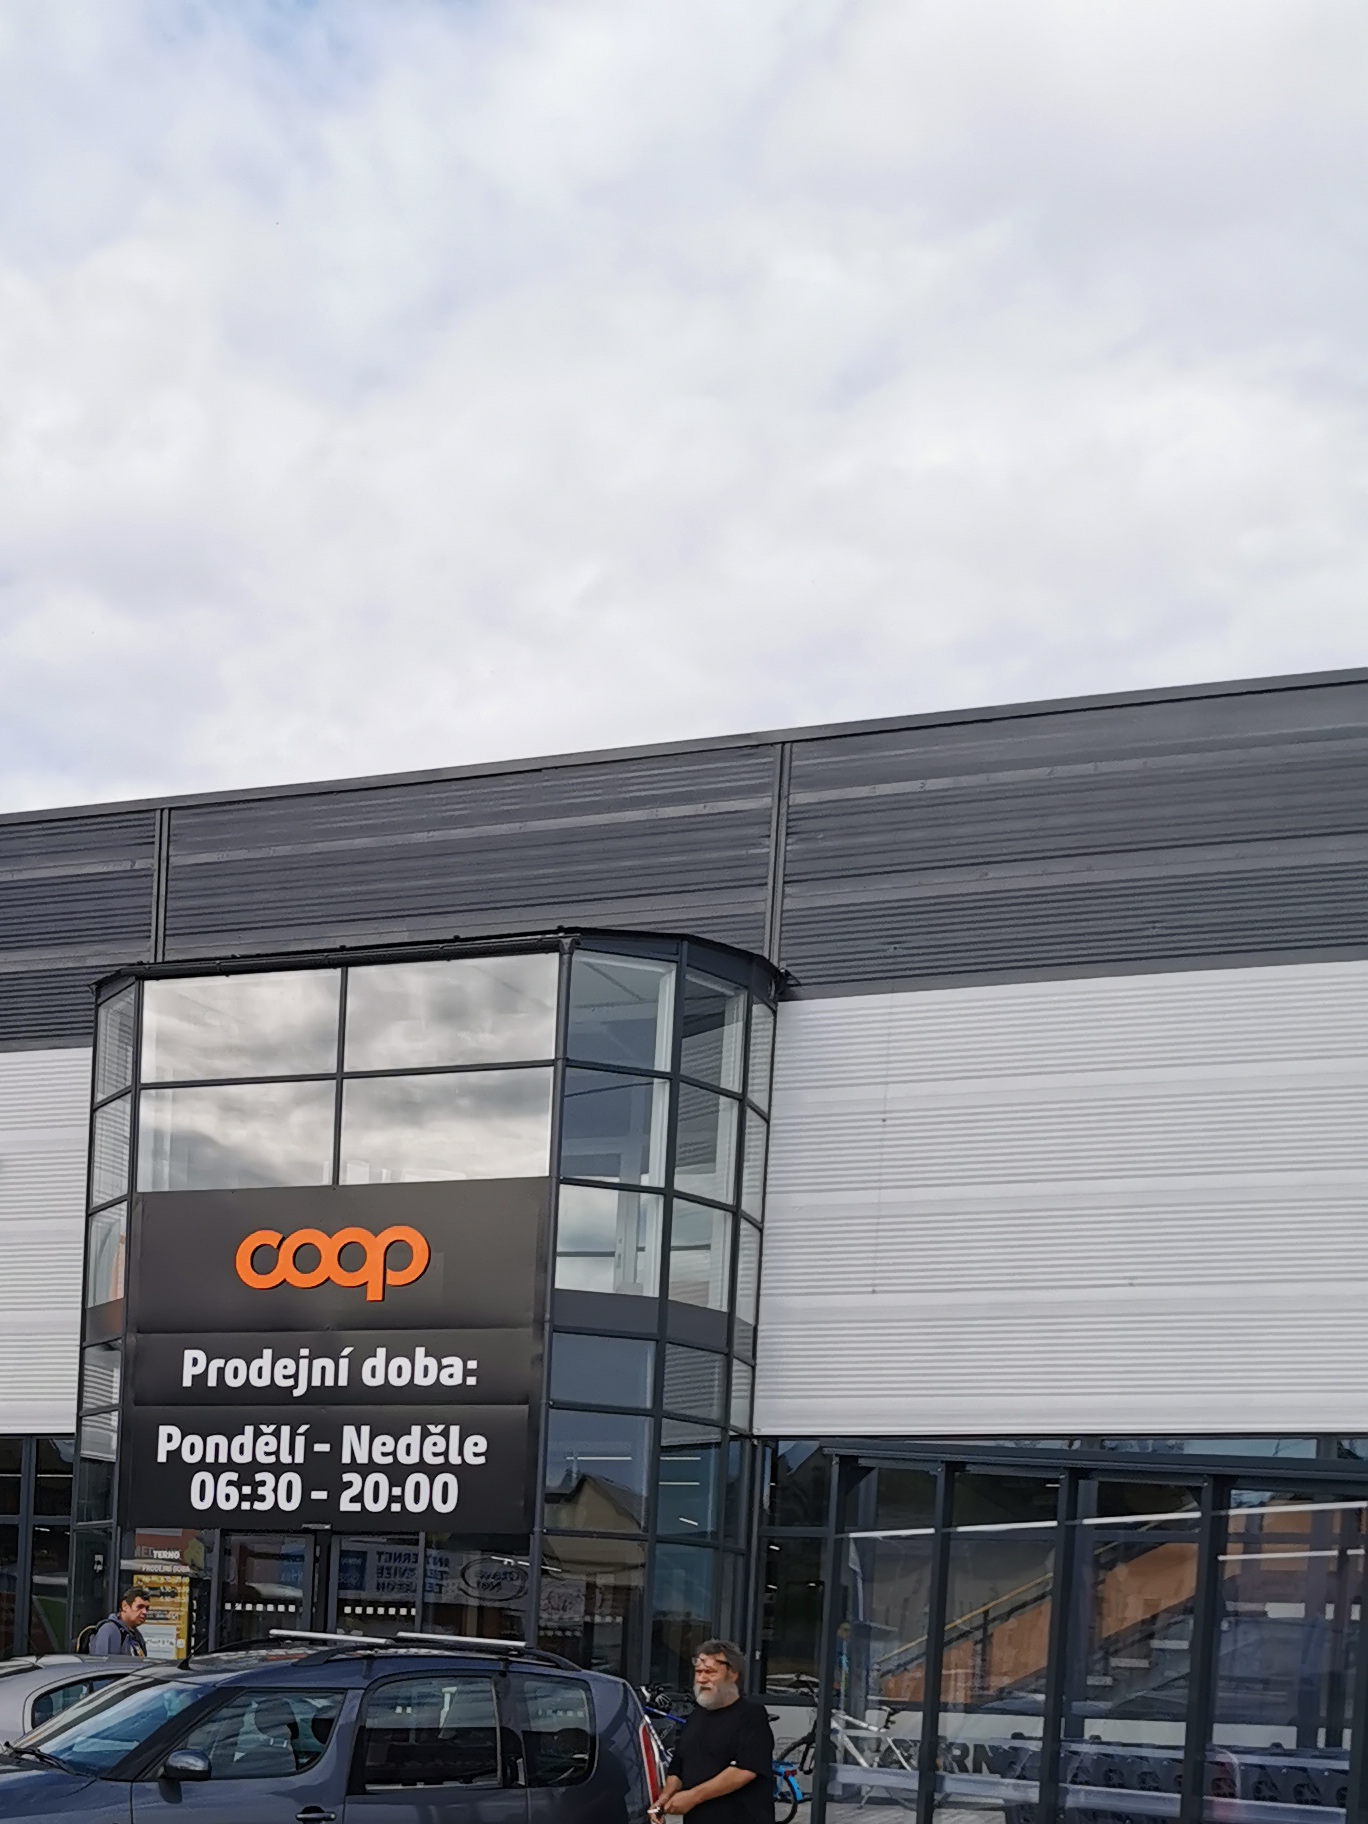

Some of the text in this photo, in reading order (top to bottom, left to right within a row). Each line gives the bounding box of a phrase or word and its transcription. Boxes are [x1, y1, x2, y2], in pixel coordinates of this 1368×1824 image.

[234, 1225, 431, 1302] coop
[182, 1346, 478, 1397] Prodejní doba:
[156, 1424, 311, 1464] Pondělí
[341, 1424, 488, 1465] Neděle
[190, 1471, 303, 1511] 06:30
[339, 1472, 459, 1513] 20:00
